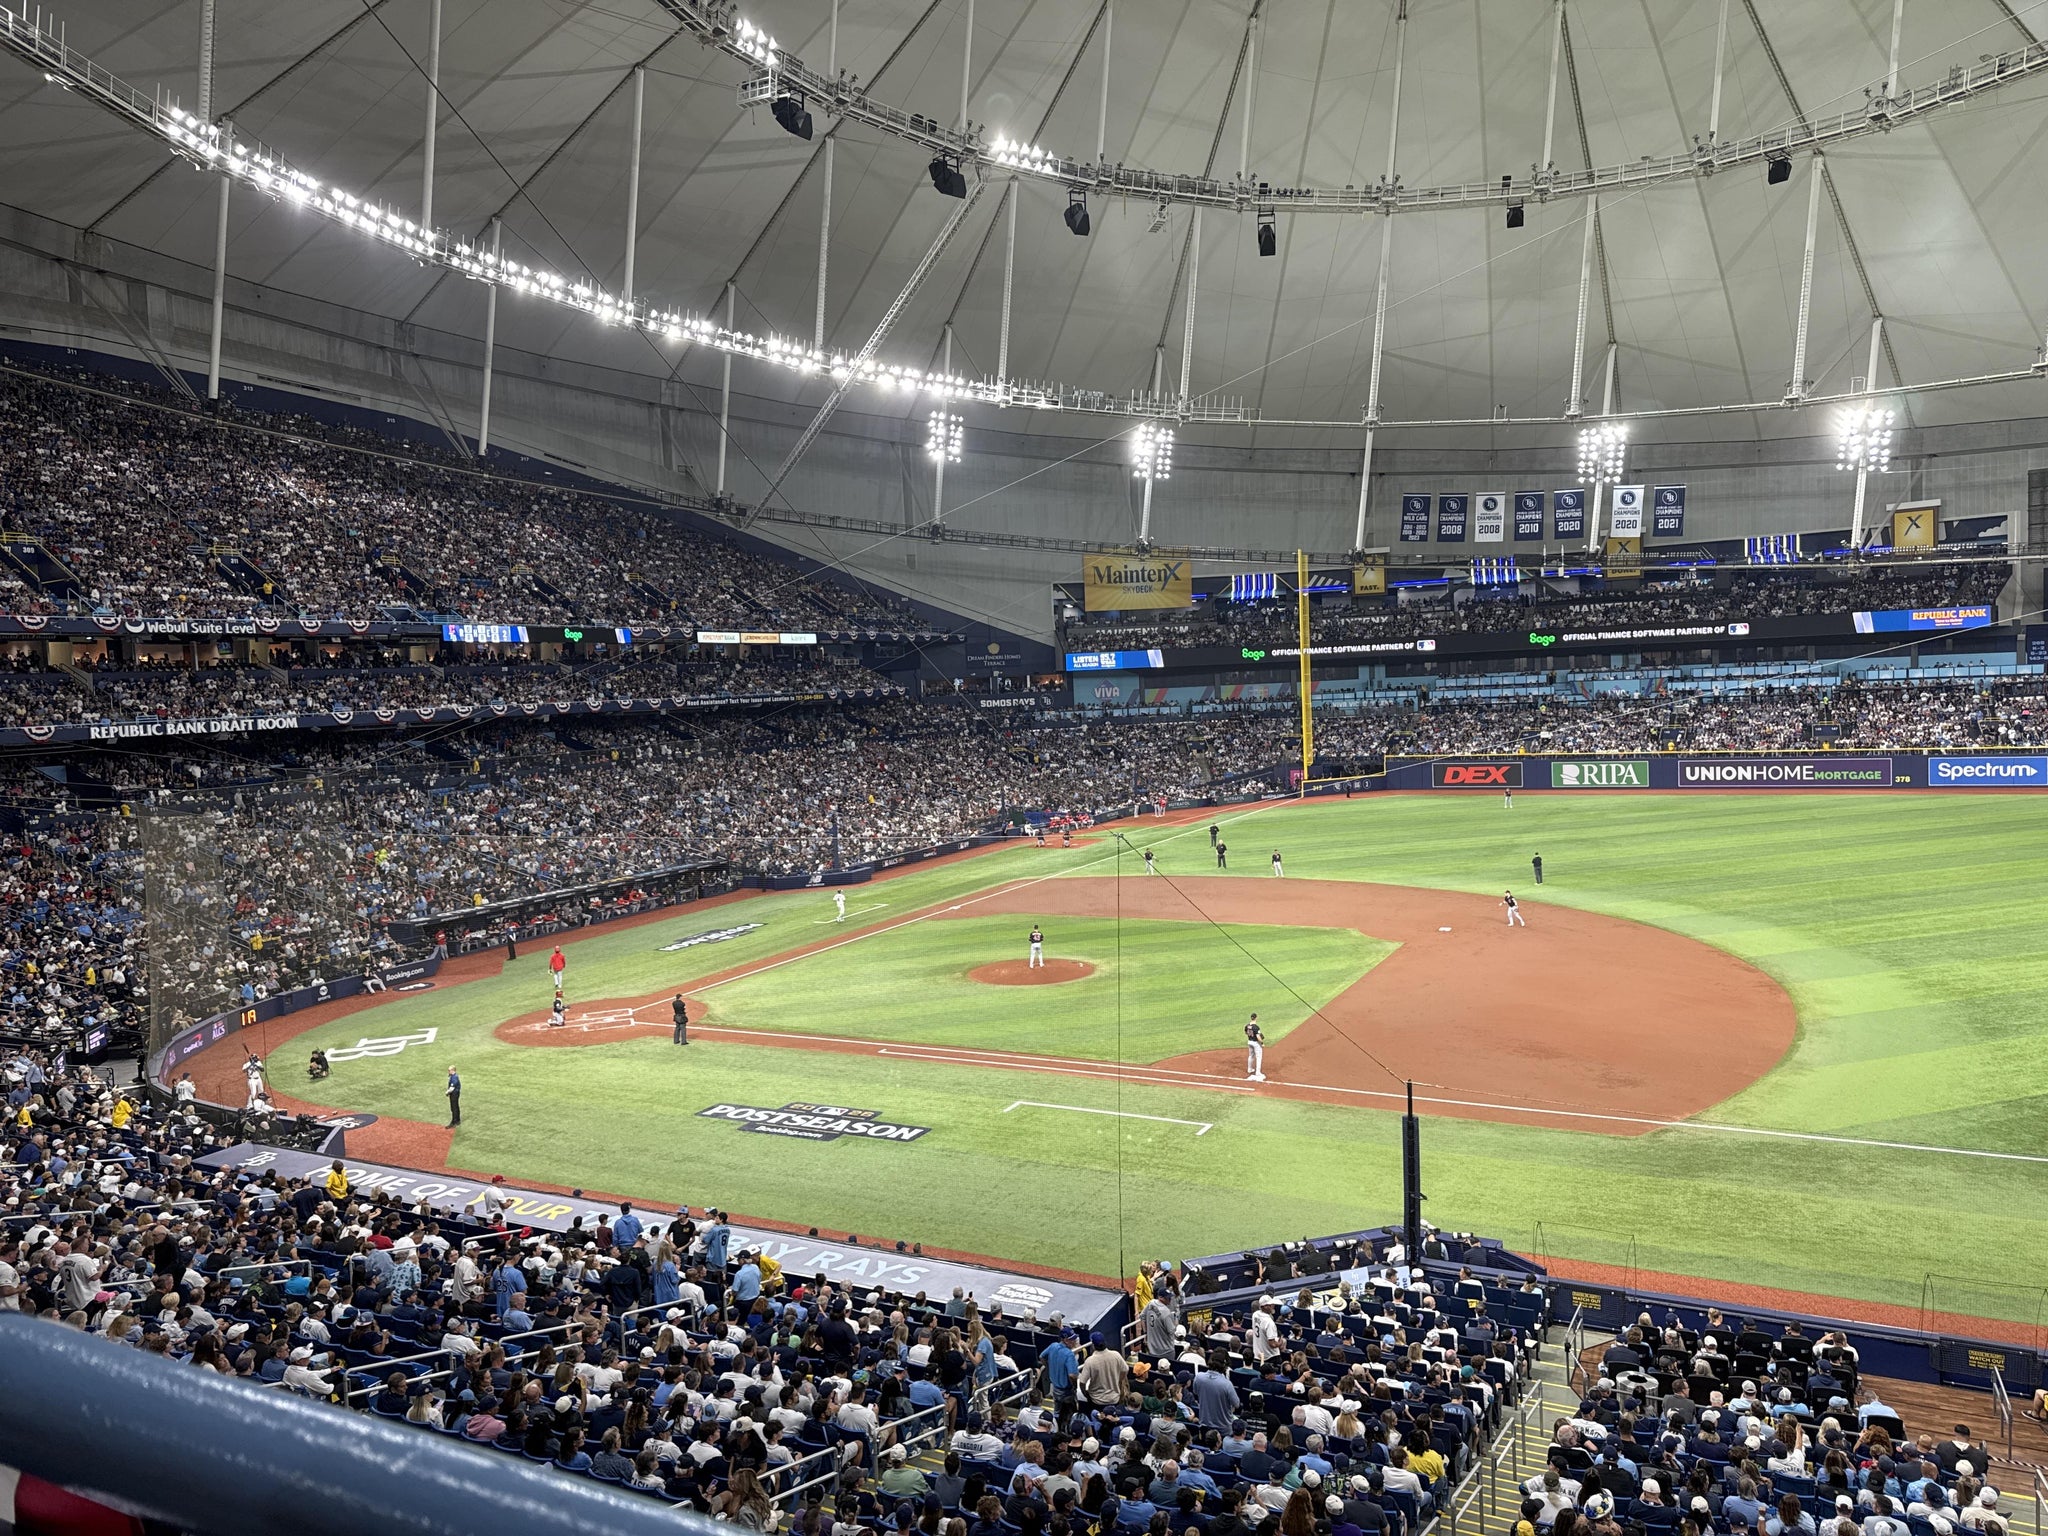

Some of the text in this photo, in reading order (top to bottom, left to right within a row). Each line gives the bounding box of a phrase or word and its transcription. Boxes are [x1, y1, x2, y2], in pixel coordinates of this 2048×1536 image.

[1441, 525, 1462, 534] 2008
[1479, 525, 1500, 534] 2008
[1519, 523, 1539, 533] 2010
[1558, 521, 1580, 531] 2020
[1615, 520, 1637, 529] 2020
[1658, 519, 1679, 528] 2021
[1093, 562, 1183, 591] MaintenX
[1679, 572, 1697, 580] EATS
[1122, 585, 1153, 594] SKYDECK
[1913, 608, 1986, 620] REPUBLIC BANK
[147, 622, 256, 634] Webull Suite Level
[1562, 625, 1725, 642] OFFICIAL FINANCE SOFTWARE PARTNER OF
[1272, 642, 1414, 657] OFFICIAL FINANCE SOFTWARE PARTNER OF
[1073, 655, 1098, 663] LISTEN
[91, 717, 298, 739] REPUBLIC BANK DRAFT ROOM
[1444, 766, 1511, 784] DEX
[1582, 764, 1640, 784] RIPA
[1814, 771, 1881, 780] MORTGAGE
[1938, 762, 2031, 780] Spectrum
[386, 968, 424, 981] Booking.com
[702, 1104, 924, 1140] POSTSEASON
[755, 1125, 823, 1139] Booking.com
[410, 1183, 471, 1201] OF
[804, 1250, 930, 1285] RAYS
